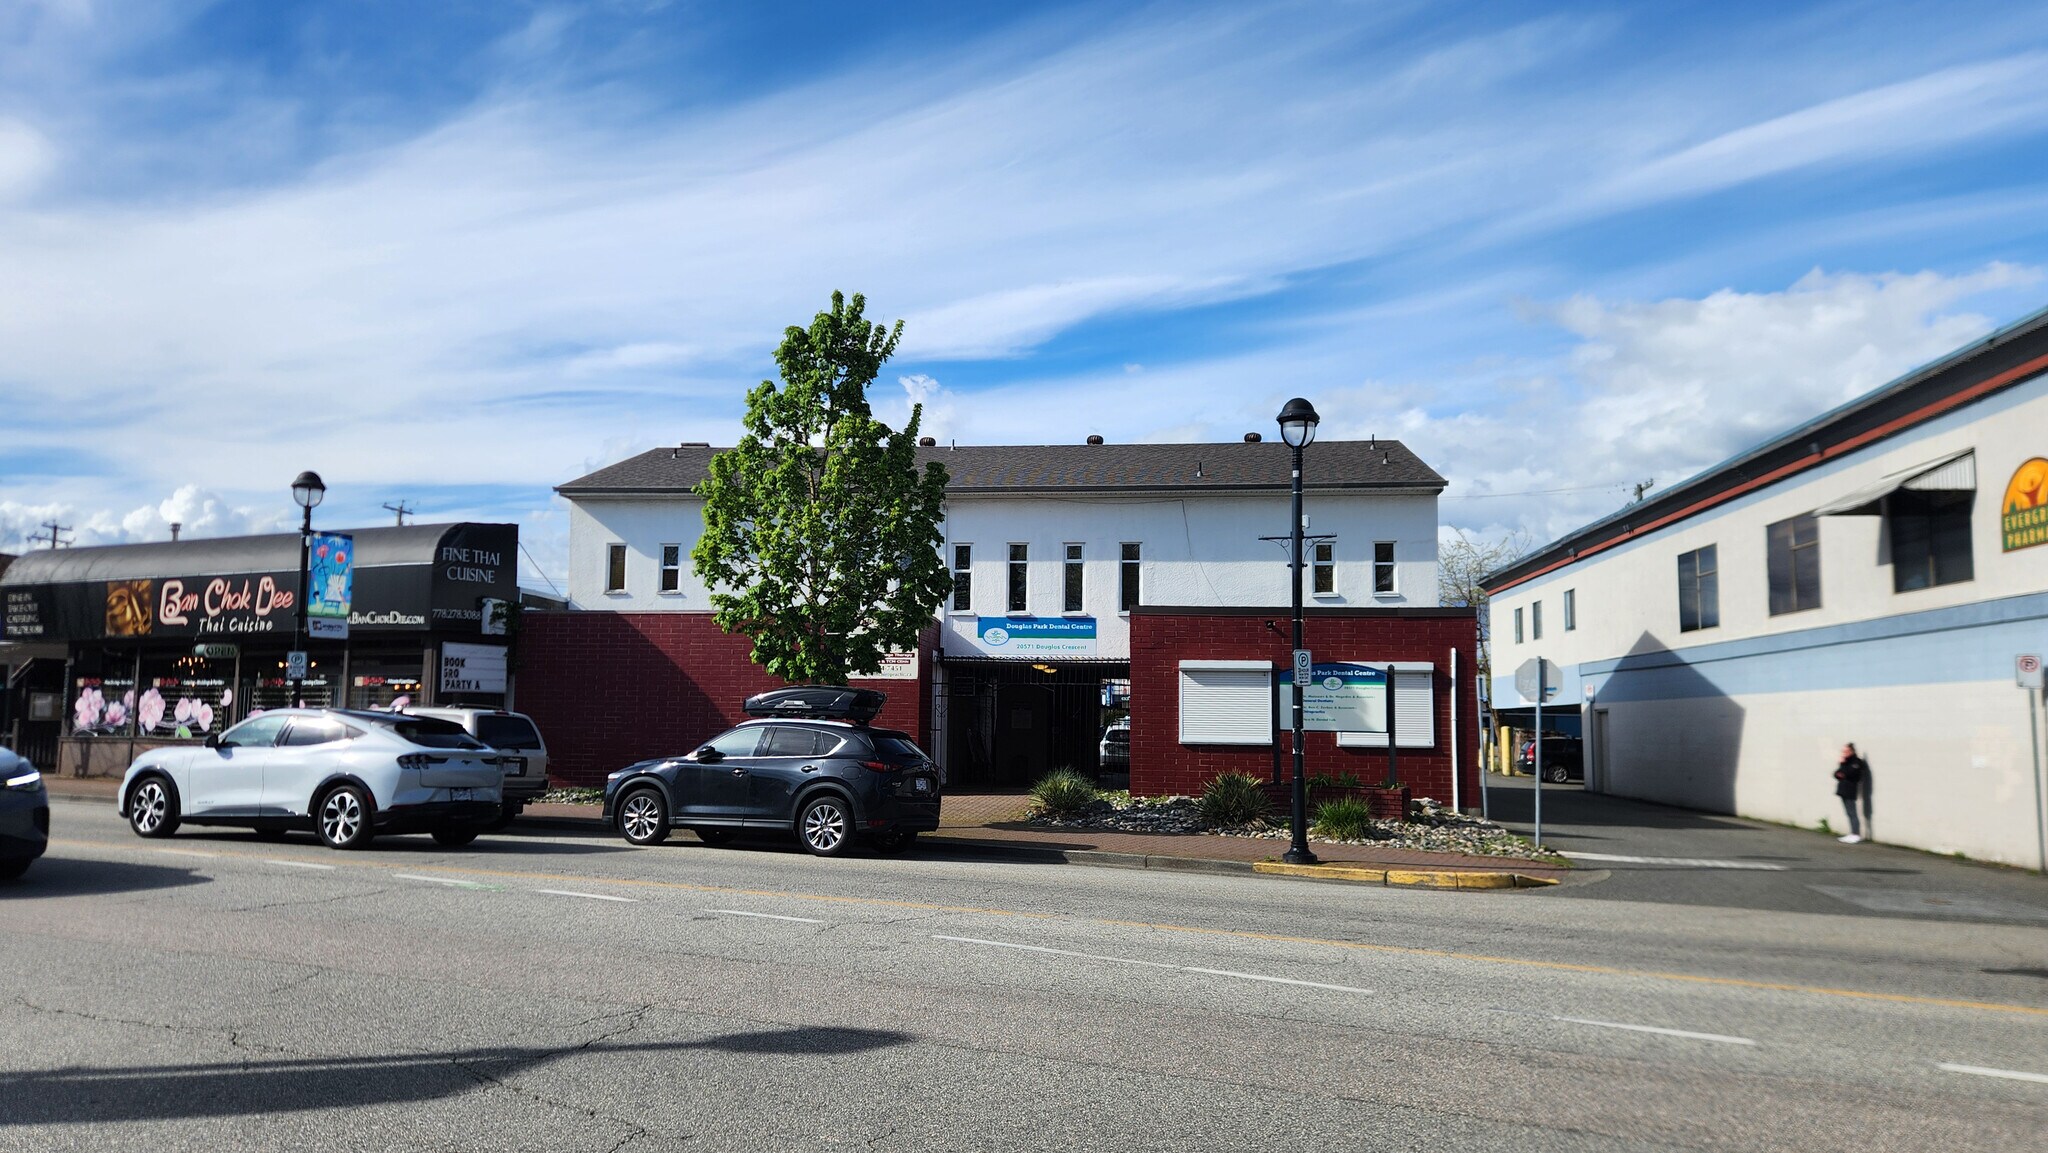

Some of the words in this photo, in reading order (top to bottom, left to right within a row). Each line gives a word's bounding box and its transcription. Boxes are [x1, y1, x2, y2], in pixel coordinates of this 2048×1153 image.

[2006, 525, 2048, 549] PHARM
[442, 547, 470, 563] FINE
[472, 549, 500, 566] THAI
[446, 566, 495, 584] CUISINE
[159, 579, 199, 626] Ban
[204, 577, 251, 617] Chok
[255, 576, 293, 616] Dee
[199, 615, 224, 633] Thai
[229, 616, 273, 633] Cuisine
[1036, 643, 1060, 651] Douglas
[444, 657, 466, 668] BOOK
[444, 680, 472, 690] PARTY
